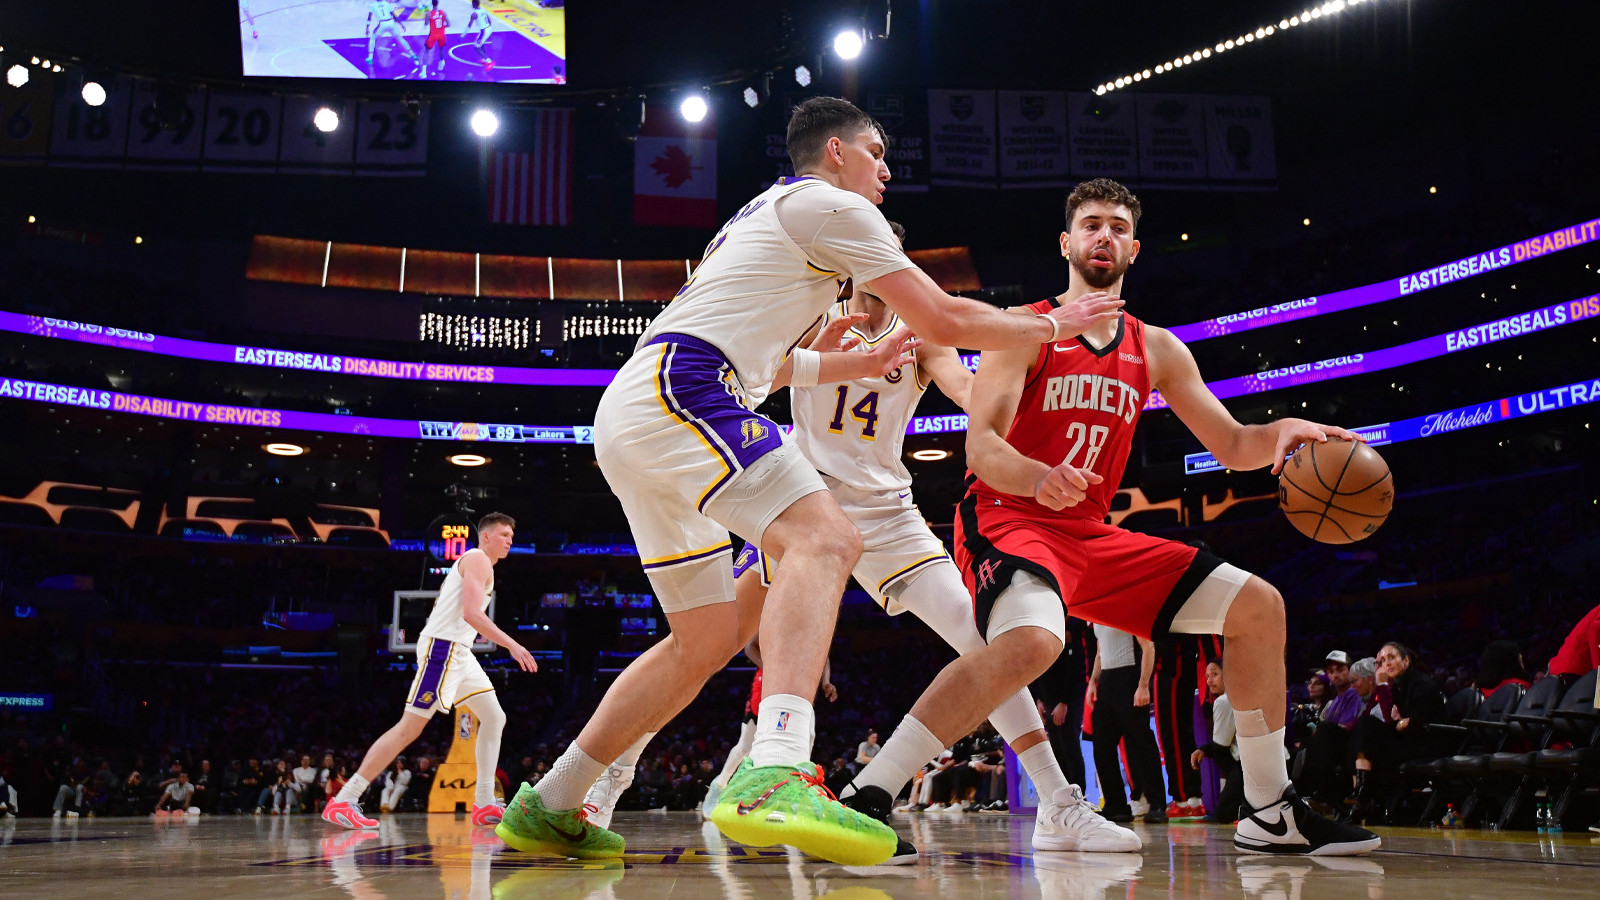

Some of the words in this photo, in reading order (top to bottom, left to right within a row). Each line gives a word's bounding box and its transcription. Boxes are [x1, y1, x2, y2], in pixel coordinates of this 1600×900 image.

[0, 100, 34, 140] 6
[67, 104, 110, 140] 18
[214, 106, 271, 146] 20
[368, 111, 416, 149] 23
[1400, 248, 1511, 295] EASTERSEALS
[1446, 305, 1567, 352] EASTERSEALS
[235, 347, 342, 371] EASTERSEALS
[344, 358, 424, 378] DISABILITY
[427, 364, 494, 382] SERVICES
[0, 379, 111, 409] ASTERSEALS
[114, 394, 203, 419] DISABILITY
[206, 407, 281, 427] SERVICES
[828, 384, 880, 442] 14
[1042, 374, 1140, 425] ROCKETS
[496, 426, 515, 440] 89
[534, 430, 565, 439] Lakers
[1420, 404, 1493, 438] Michelob
[1062, 421, 1110, 472] 28
[442, 525, 469, 539] 2:44
[445, 537, 467, 560] 10
